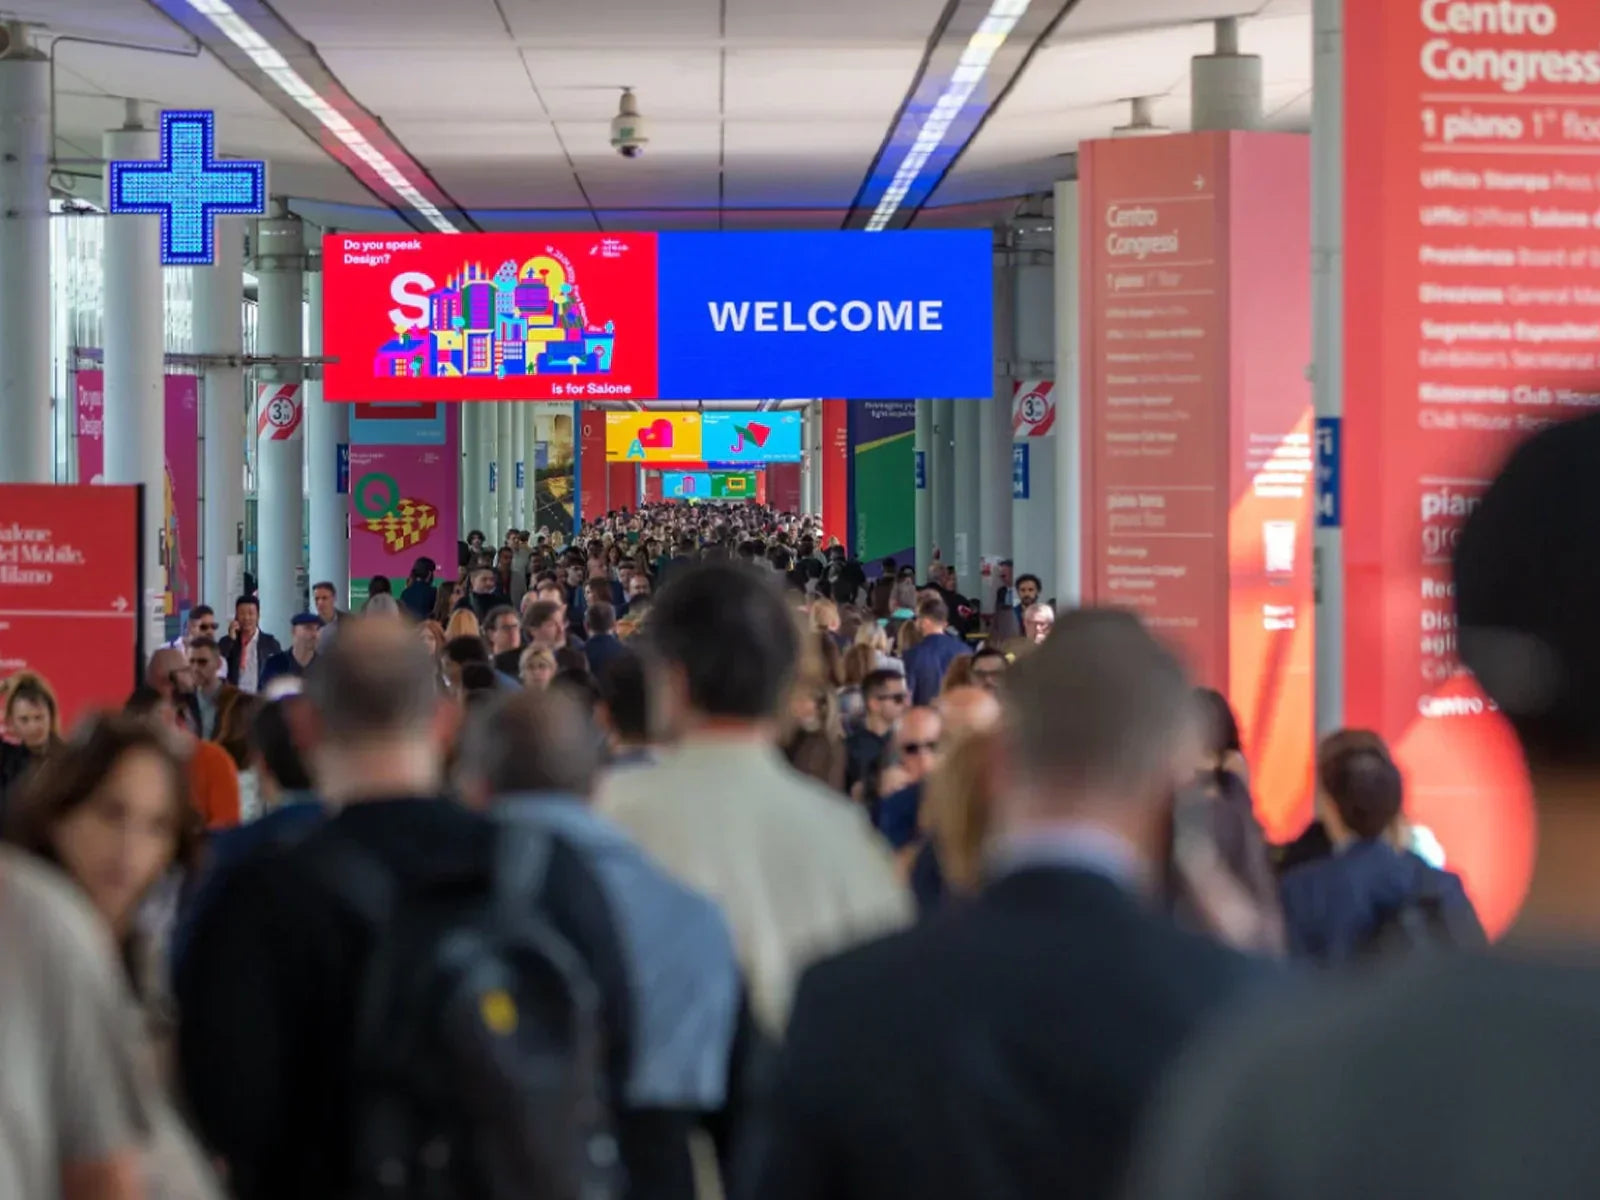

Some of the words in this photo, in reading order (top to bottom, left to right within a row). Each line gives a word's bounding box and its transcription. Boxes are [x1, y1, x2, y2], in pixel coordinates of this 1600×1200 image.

[1420, 0, 1556, 34] Centro
[1420, 40, 1600, 92] Congress
[1443, 108, 1524, 143] piano
[1105, 204, 1157, 228] Centro
[344, 239, 360, 250] Do
[362, 241, 384, 252] you
[386, 239, 422, 252] speak
[1105, 230, 1179, 260] Congressi
[344, 253, 392, 267] Design?
[388, 271, 436, 330] S
[708, 300, 943, 332] WELCOME
[552, 383, 563, 394] is
[566, 383, 584, 394] for
[587, 383, 632, 394] Salone
[273, 403, 282, 420] 3
[1025, 400, 1033, 417] 3
[627, 439, 646, 458] A
[354, 472, 400, 519] Q
[0, 565, 52, 584] ilano
